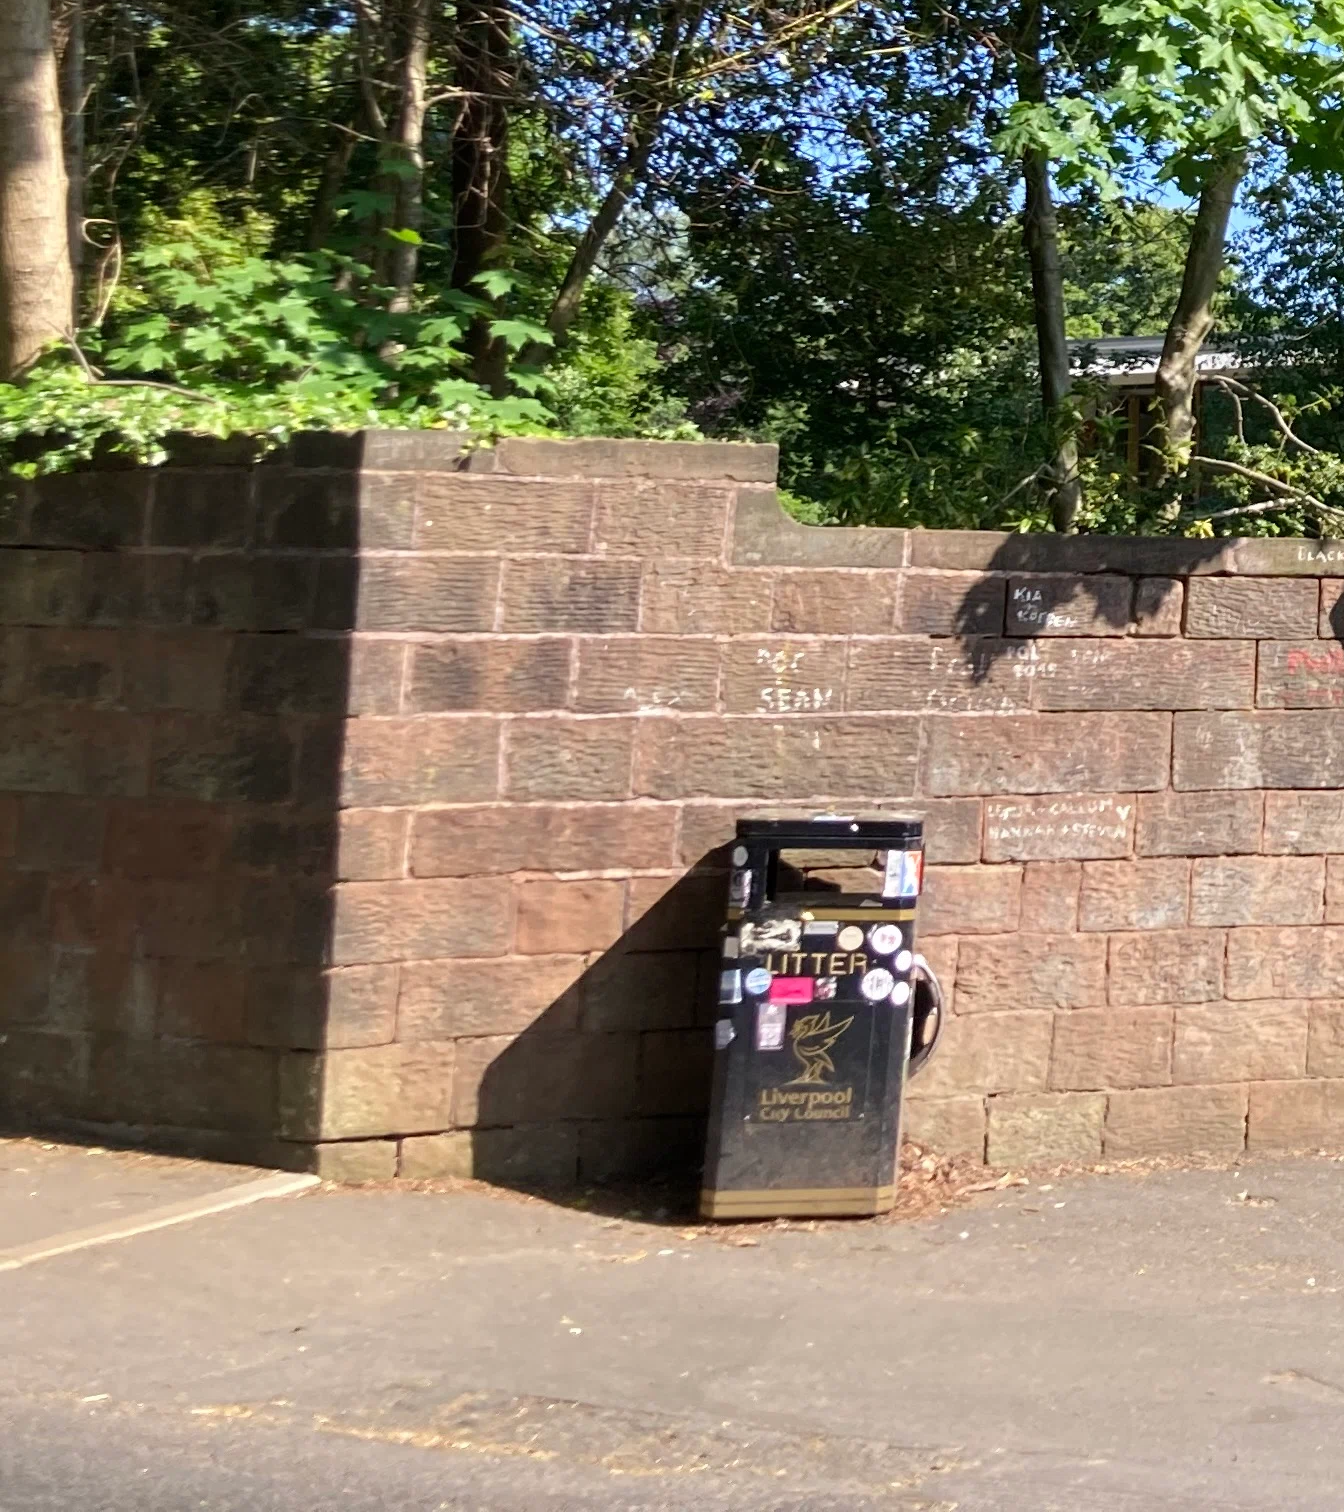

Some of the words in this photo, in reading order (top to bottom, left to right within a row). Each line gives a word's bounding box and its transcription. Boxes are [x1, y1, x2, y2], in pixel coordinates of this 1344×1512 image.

[765, 953, 868, 975] LITTER
[761, 1087, 853, 1111] Liverpool
[793, 1105, 850, 1120] Council
